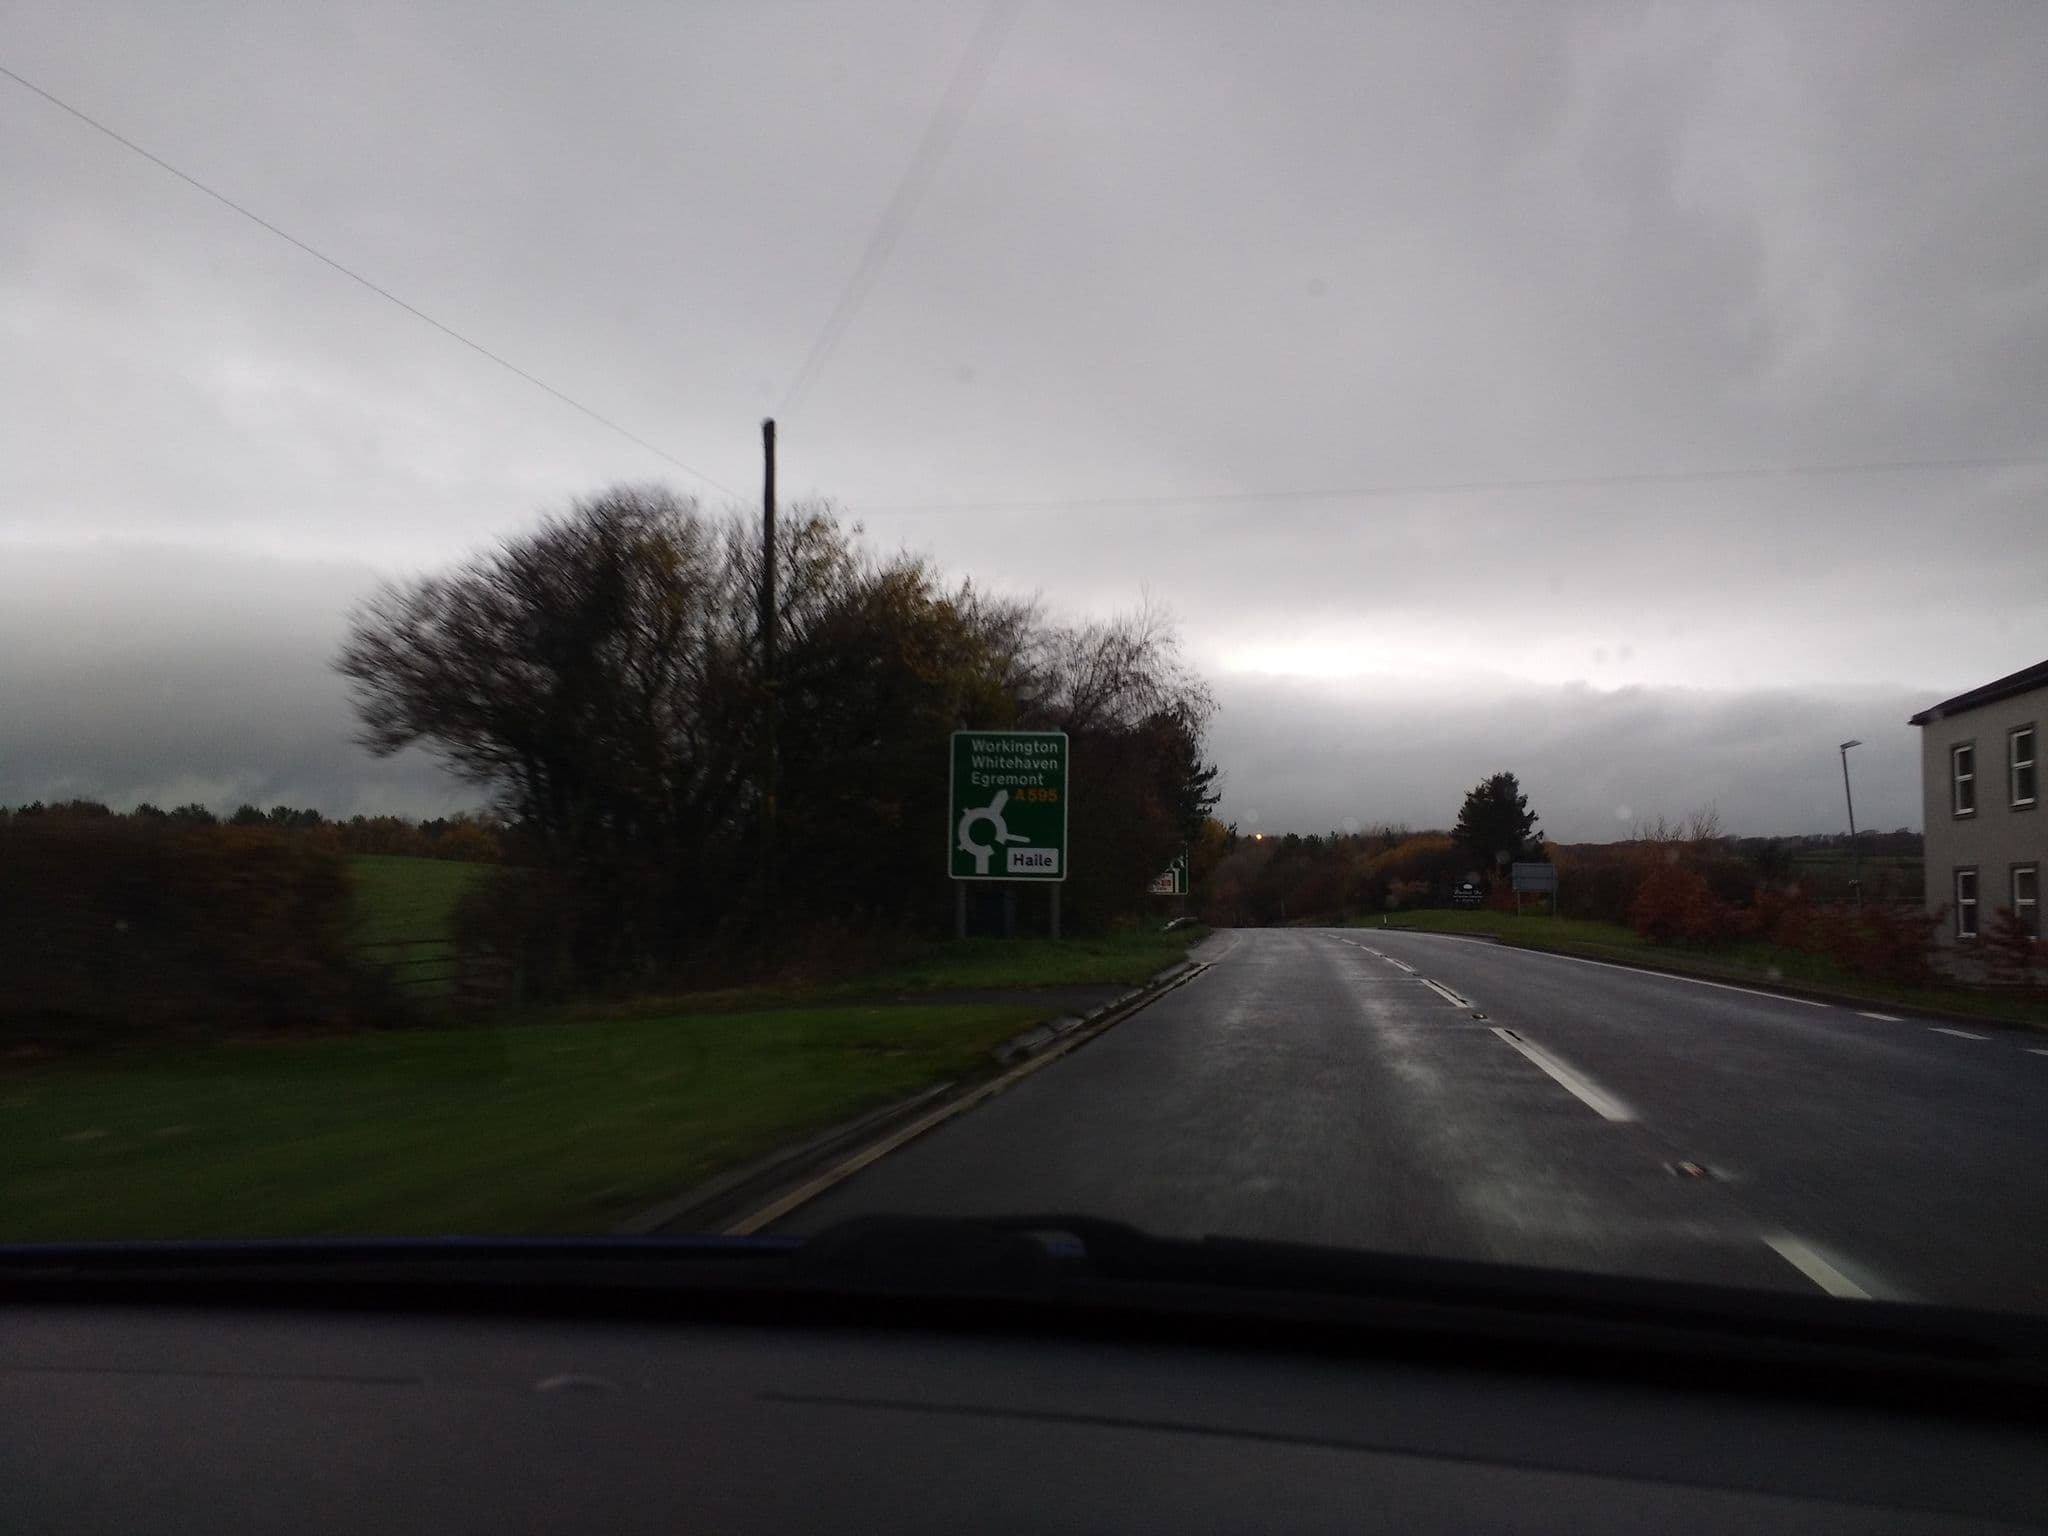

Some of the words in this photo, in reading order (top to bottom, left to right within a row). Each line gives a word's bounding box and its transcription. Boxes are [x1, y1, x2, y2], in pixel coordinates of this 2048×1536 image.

[971, 739, 1058, 755] Workington
[971, 755, 1058, 769] Whitehaven
[971, 771, 1044, 787] Egremont
[1013, 853, 1053, 867] Haile
